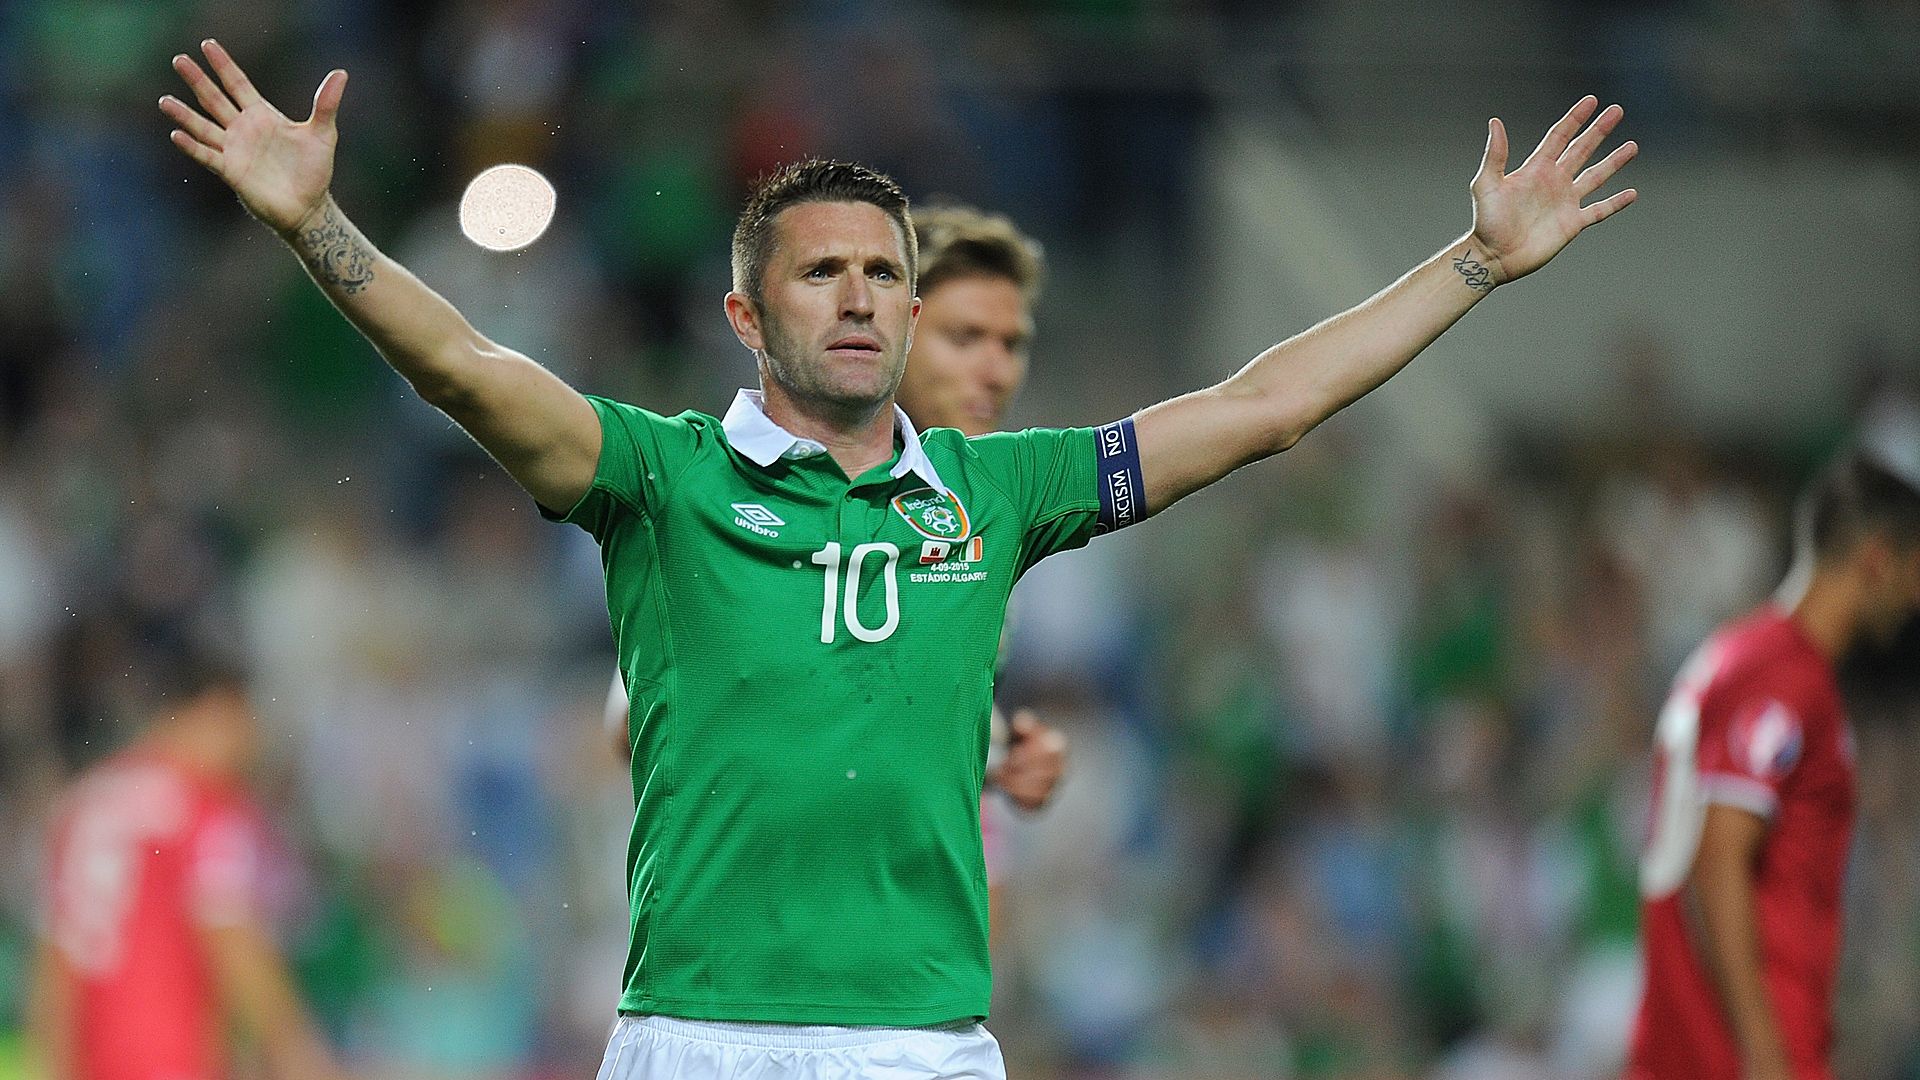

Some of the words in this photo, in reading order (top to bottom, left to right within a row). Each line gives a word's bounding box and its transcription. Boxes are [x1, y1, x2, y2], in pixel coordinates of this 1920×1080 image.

[1112, 469, 1132, 526] RACISM
[734, 516, 779, 538] umbro
[930, 562, 970, 572] 4-09-2015
[812, 542, 900, 644] 10
